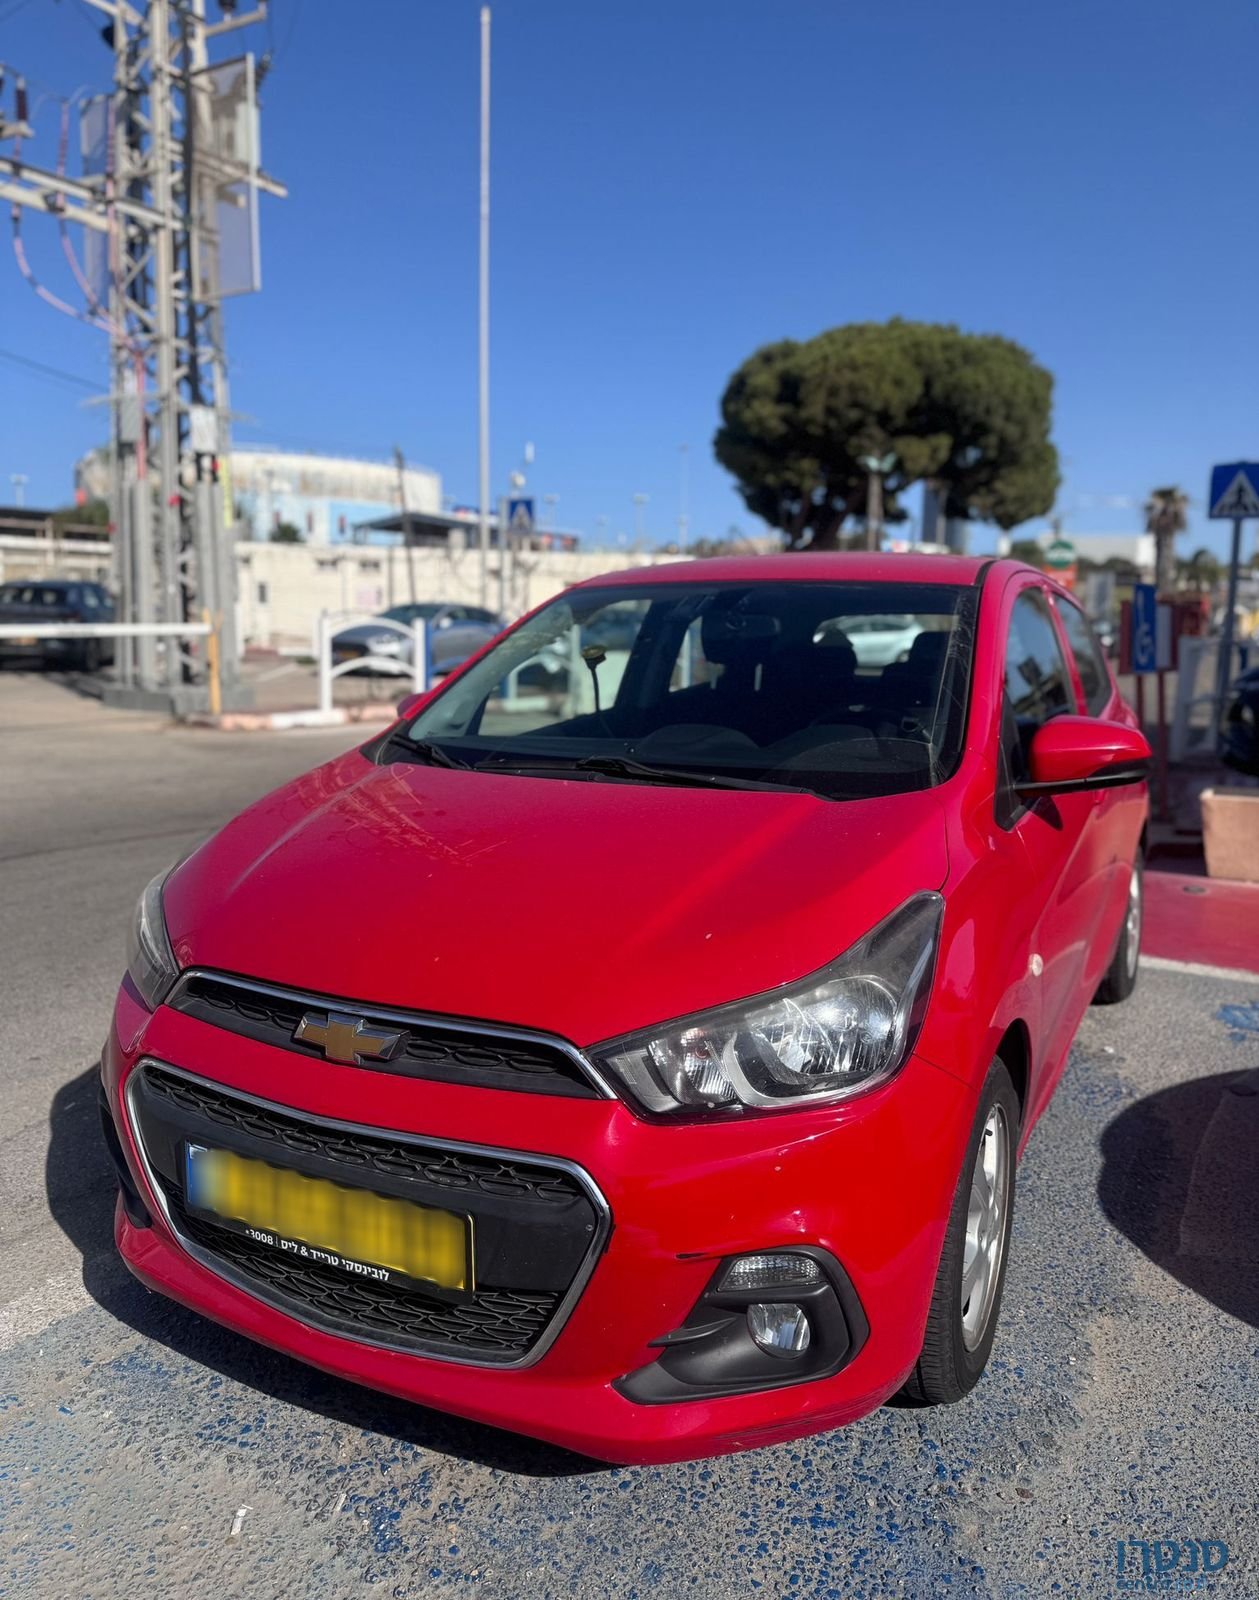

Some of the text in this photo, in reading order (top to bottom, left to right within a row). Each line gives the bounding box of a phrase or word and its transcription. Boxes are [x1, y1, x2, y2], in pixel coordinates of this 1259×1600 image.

[281, 1239, 298, 1253] ליס
[300, 1246, 309, 1257] &
[310, 1249, 339, 1266] טרייד
[341, 1258, 390, 1281] לובינסקי
